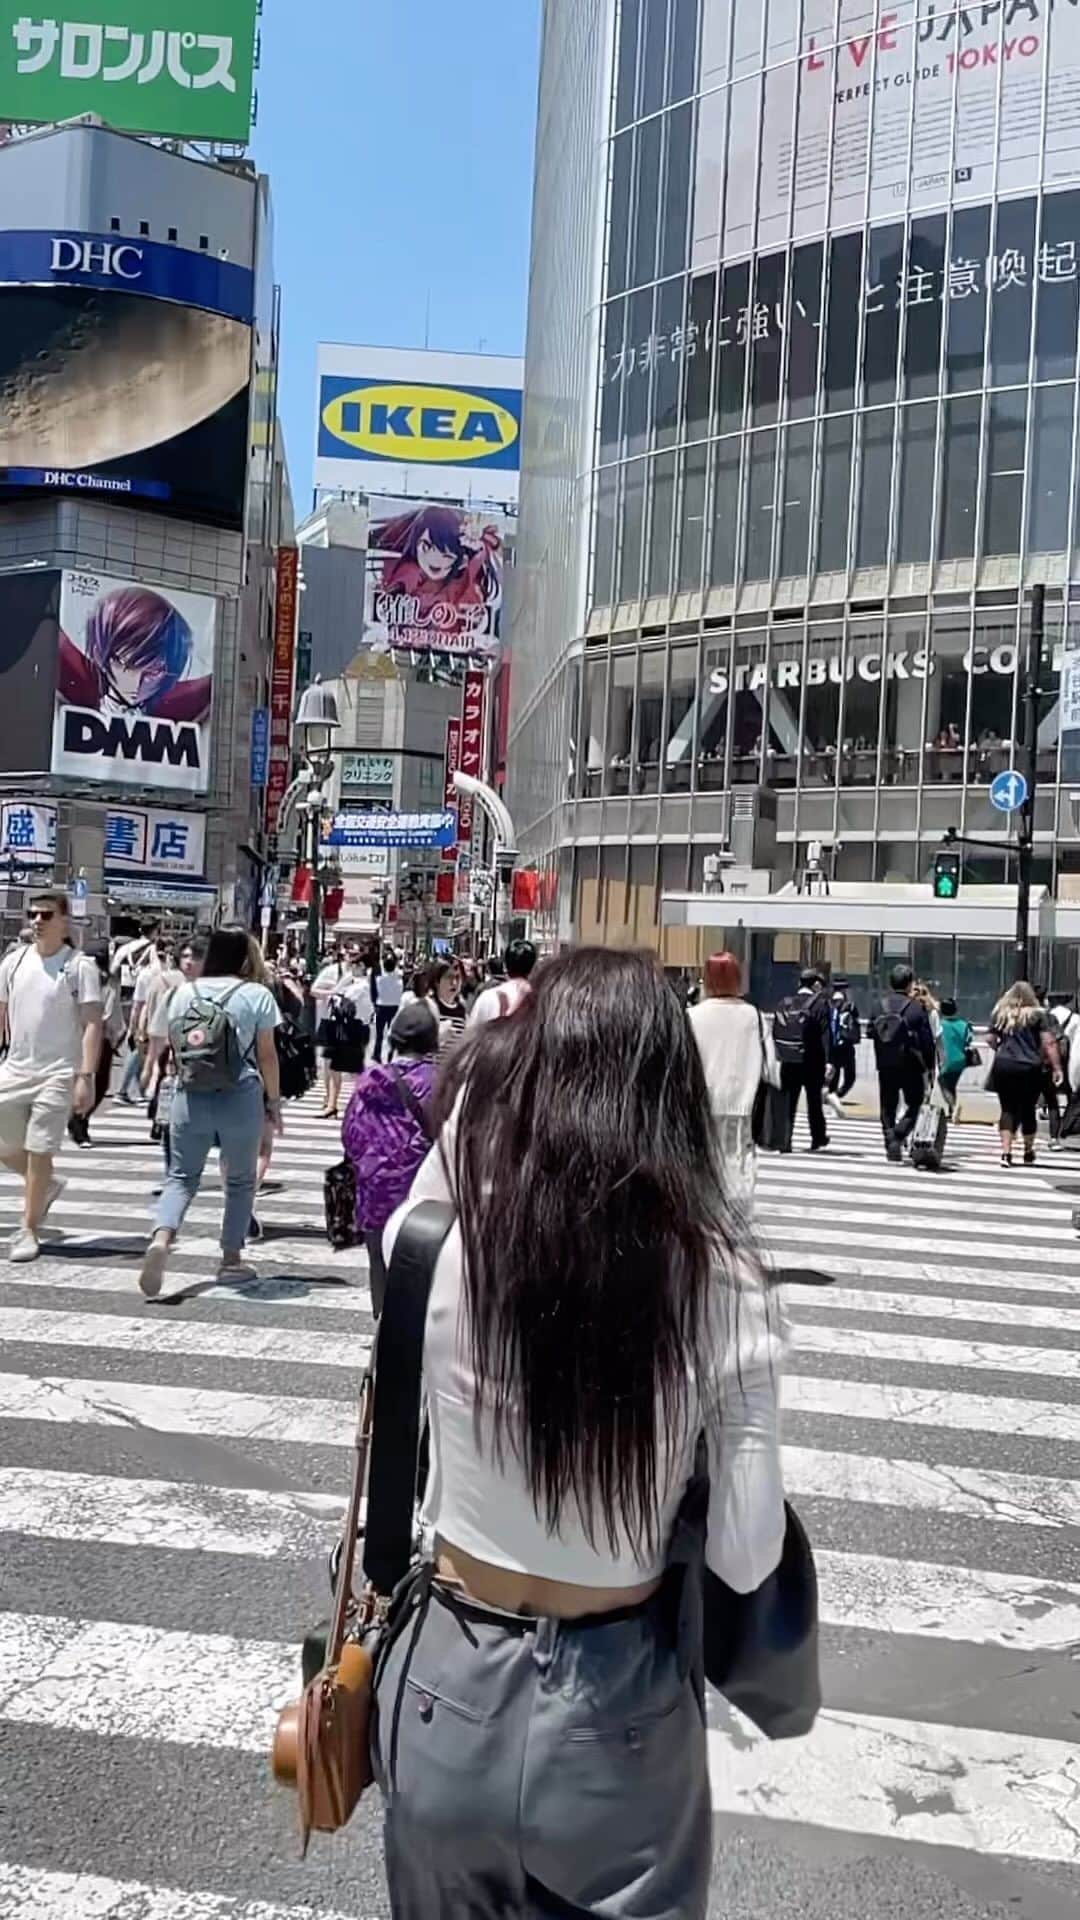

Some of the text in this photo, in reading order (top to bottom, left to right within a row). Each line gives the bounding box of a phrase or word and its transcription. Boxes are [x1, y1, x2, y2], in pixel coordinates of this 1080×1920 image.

[12, 17, 236, 93] サロンパス
[806, 0, 1077, 72] LVE JAPA
[946, 36, 1040, 74] TOKYO
[50, 238, 143, 279] DHC
[340, 402, 504, 444] IKEA
[44, 471, 132, 492] DHC Channel
[710, 650, 935, 694] STARBUCKS
[62, 710, 200, 769] DMM
[462, 681, 482, 767] カラオケ
[105, 815, 189, 859] 書店
